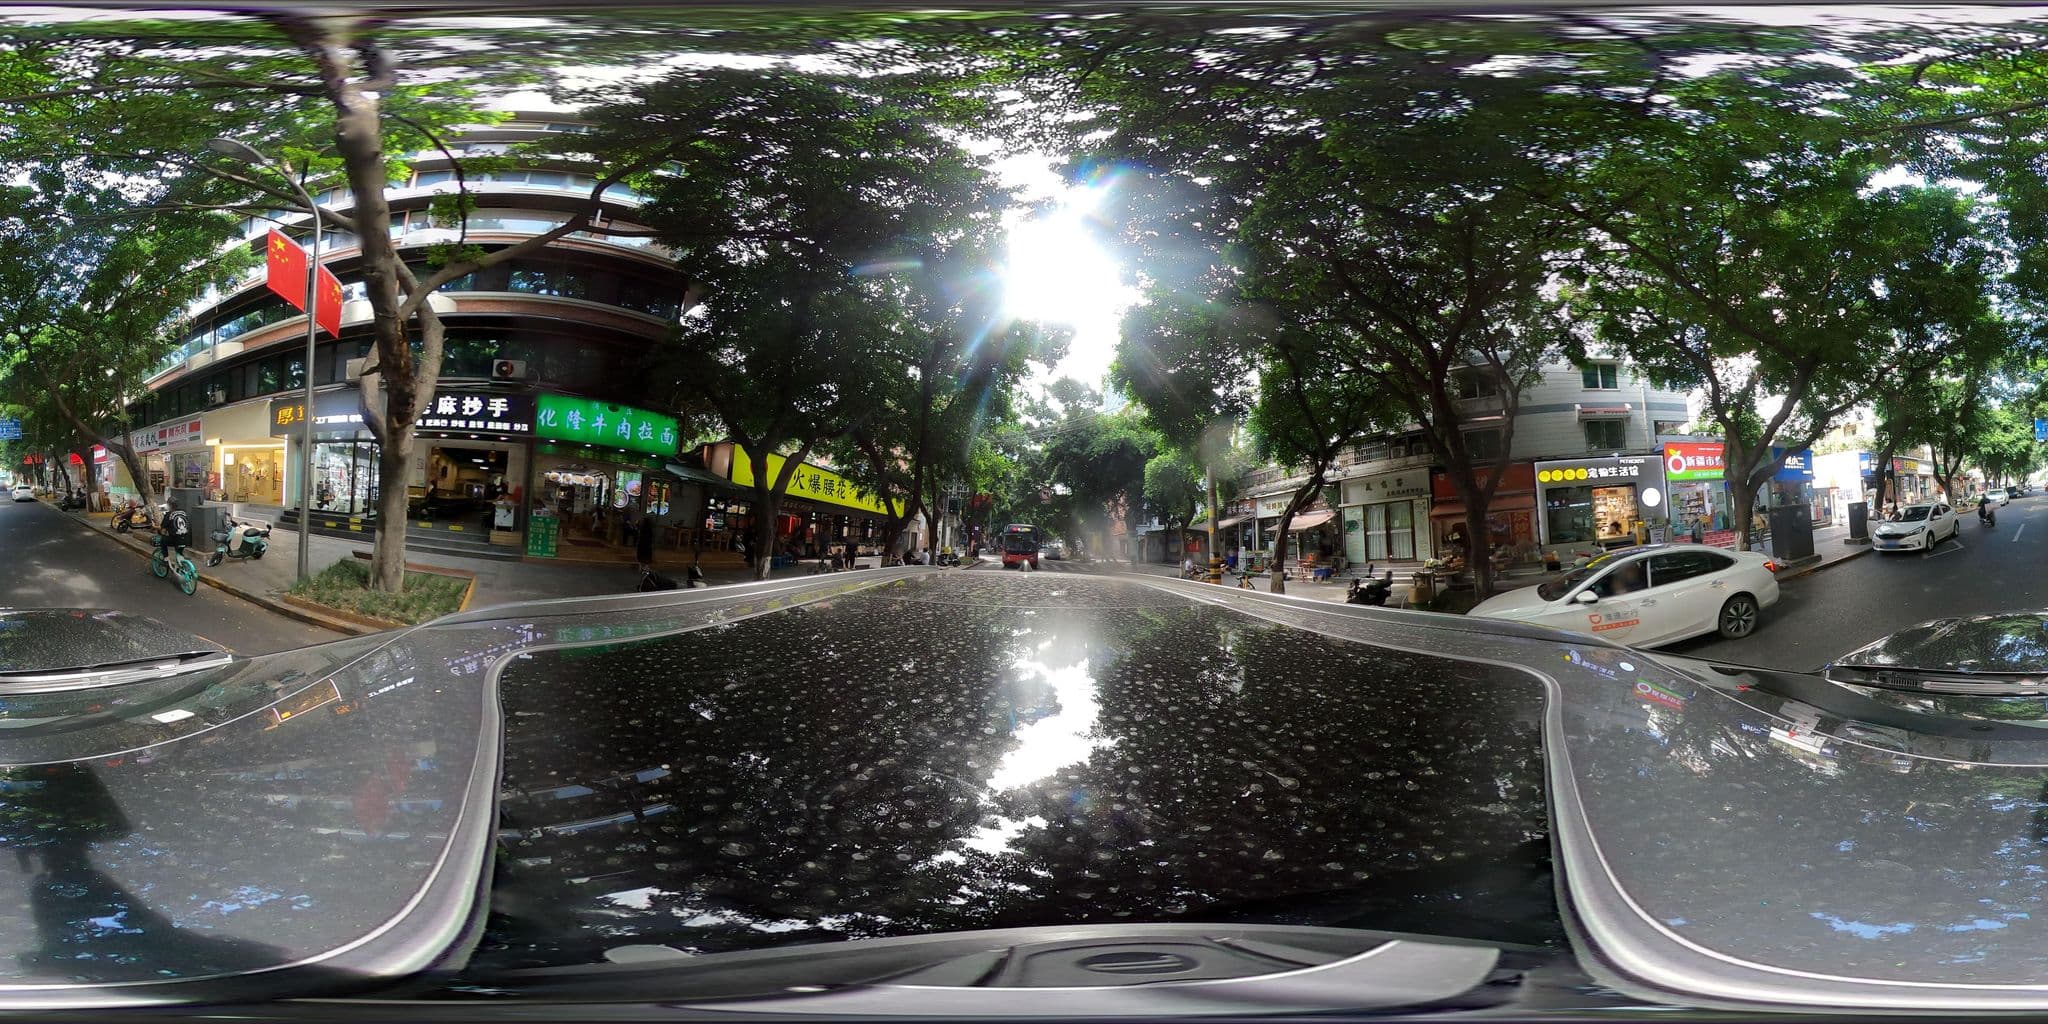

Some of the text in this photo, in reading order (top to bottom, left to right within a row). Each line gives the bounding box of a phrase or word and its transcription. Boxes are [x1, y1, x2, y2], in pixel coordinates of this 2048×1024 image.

[422, 395, 509, 417] 麻抄手
[538, 408, 675, 446] 化隆牛肉拉面
[1587, 465, 1639, 479] 宠物生活馆
